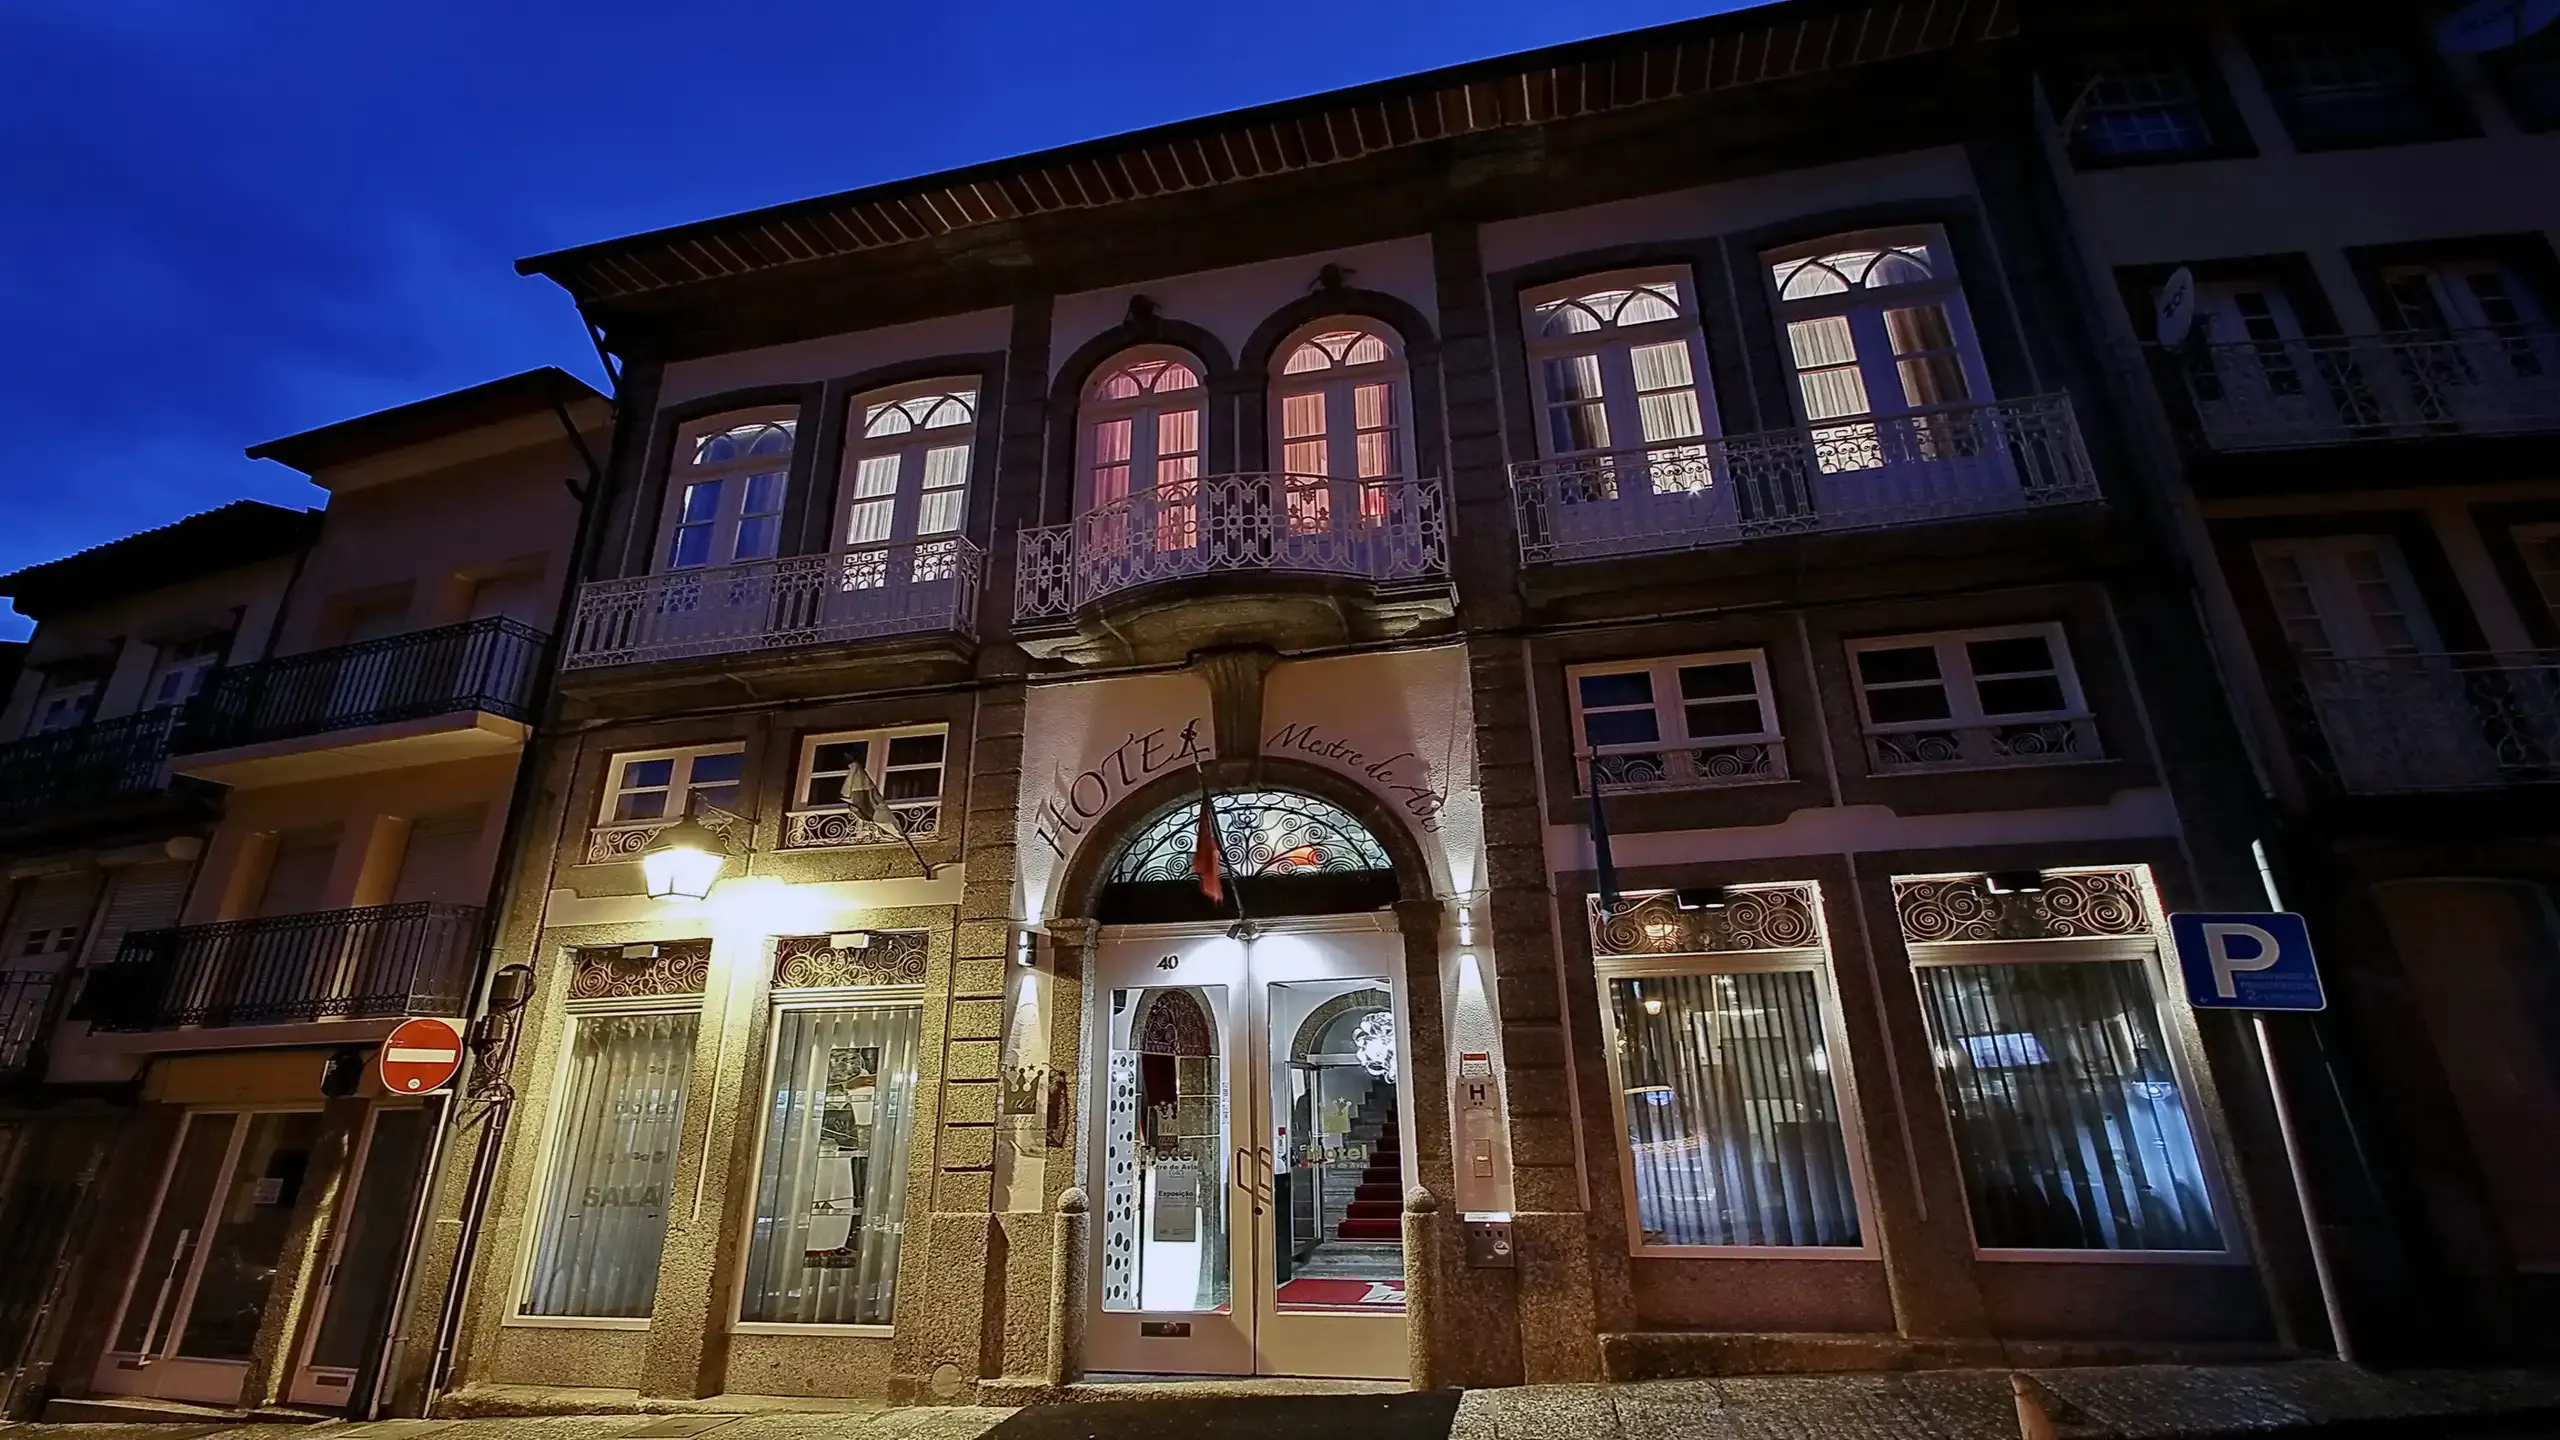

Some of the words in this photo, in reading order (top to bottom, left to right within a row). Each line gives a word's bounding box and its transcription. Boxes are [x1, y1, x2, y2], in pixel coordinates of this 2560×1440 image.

[1266, 723, 1364, 766] Mestre
[1364, 753, 1414, 782] de
[1033, 717, 1210, 861] HOTEL
[1156, 955, 1179, 970] 40
[2201, 922, 2281, 998] P
[1469, 1084, 1485, 1100] H
[582, 1186, 663, 1207] SALA
